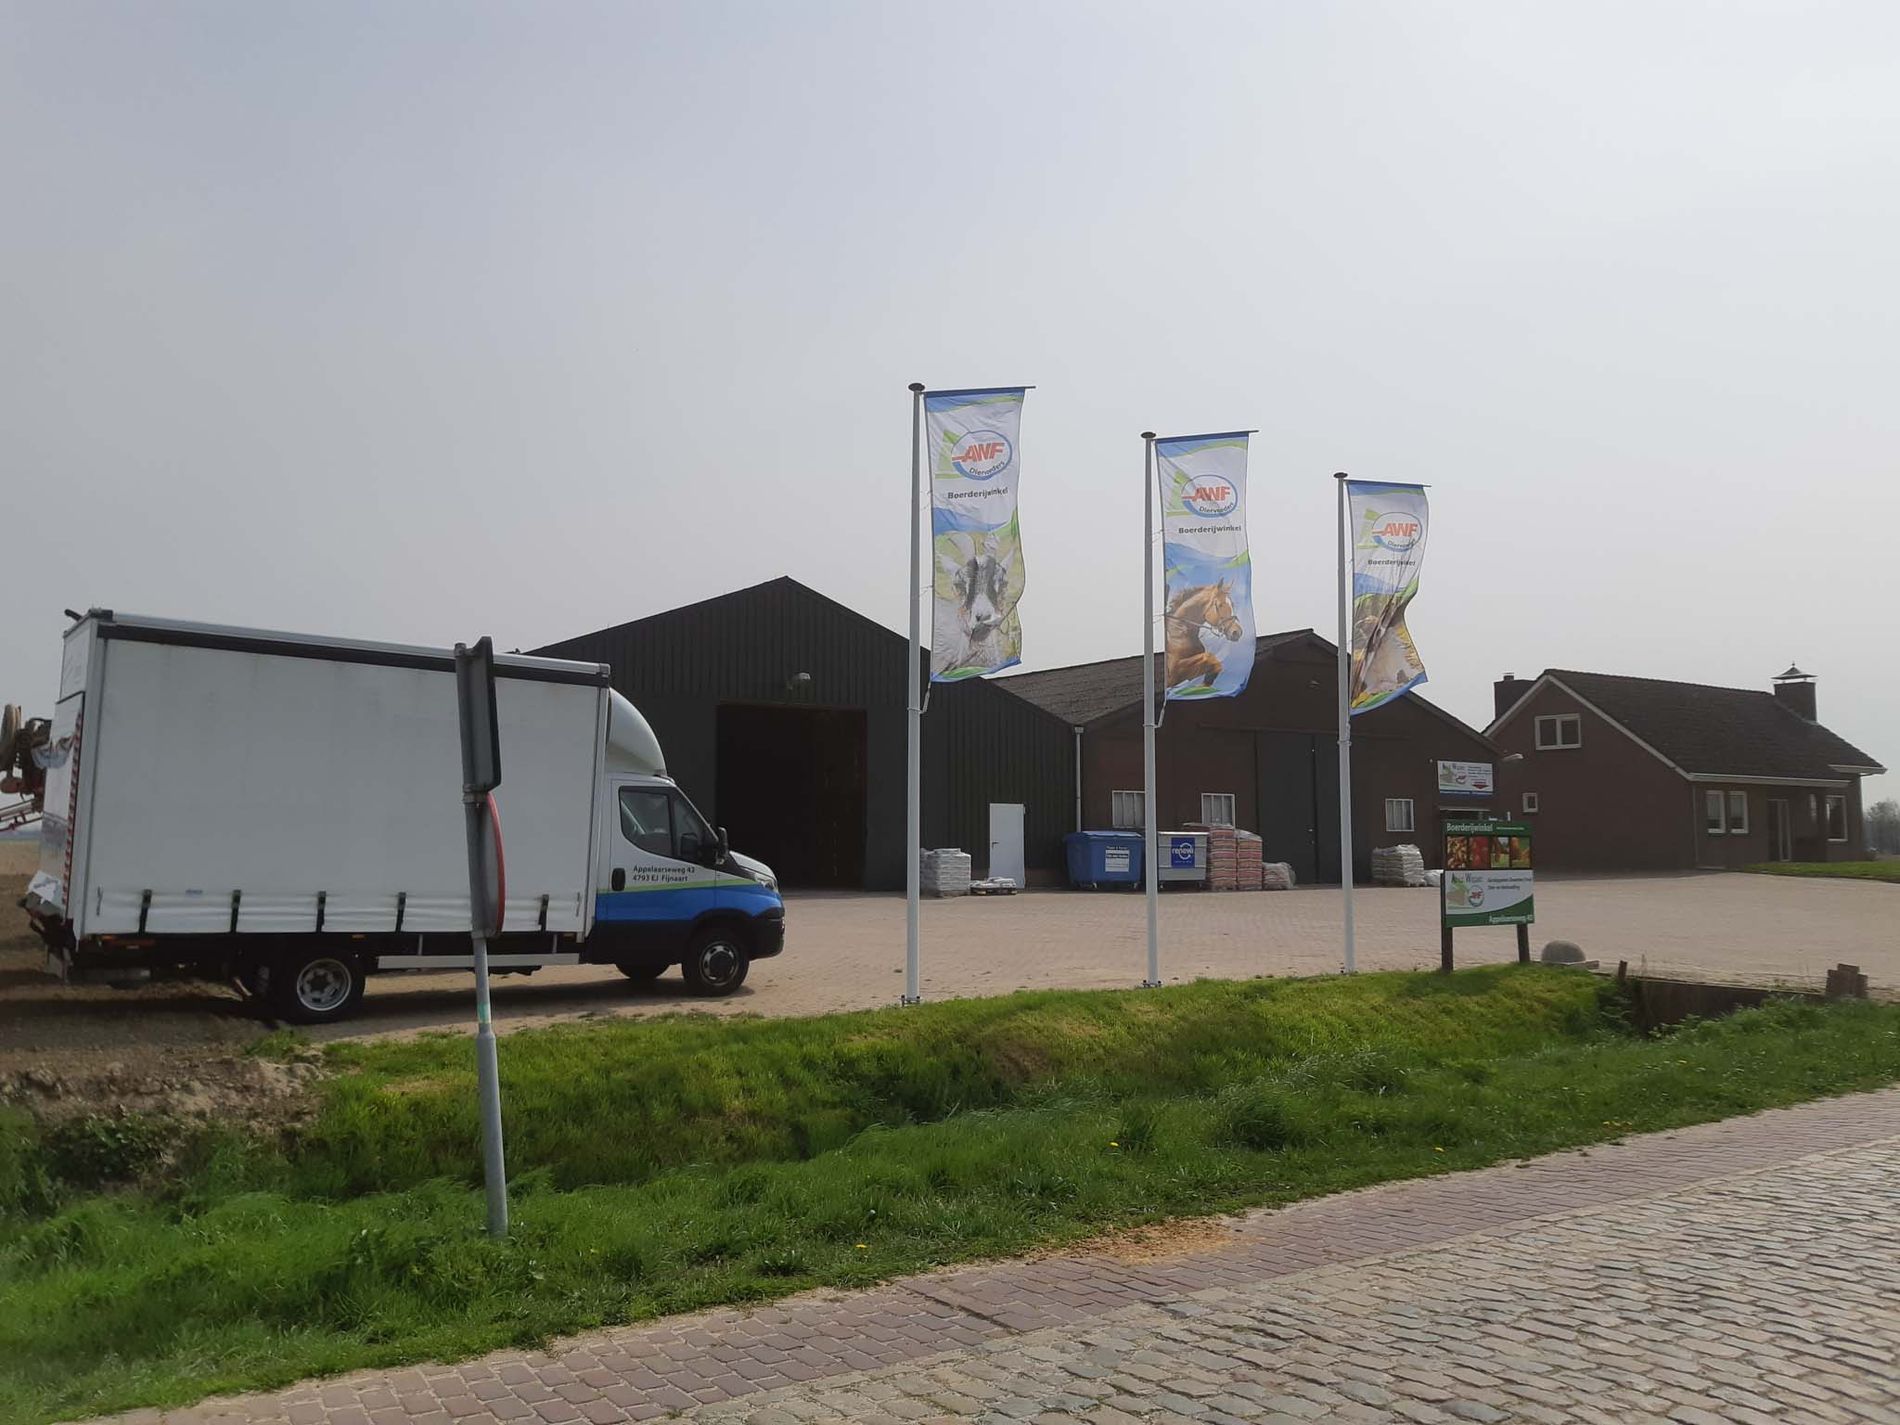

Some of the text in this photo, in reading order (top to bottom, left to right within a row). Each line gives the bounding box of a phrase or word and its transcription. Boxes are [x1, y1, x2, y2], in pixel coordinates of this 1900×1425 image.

[953, 442, 1005, 463] AWF
[947, 487, 1009, 500] Boerderijwinkel
[1184, 486, 1231, 502] AWF
[1178, 525, 1242, 534] Boerderijwinkel
[1374, 523, 1418, 537] AWF
[1447, 822, 1493, 833] Boerderijwinkel
[661, 874, 688, 882] Fijnaart
